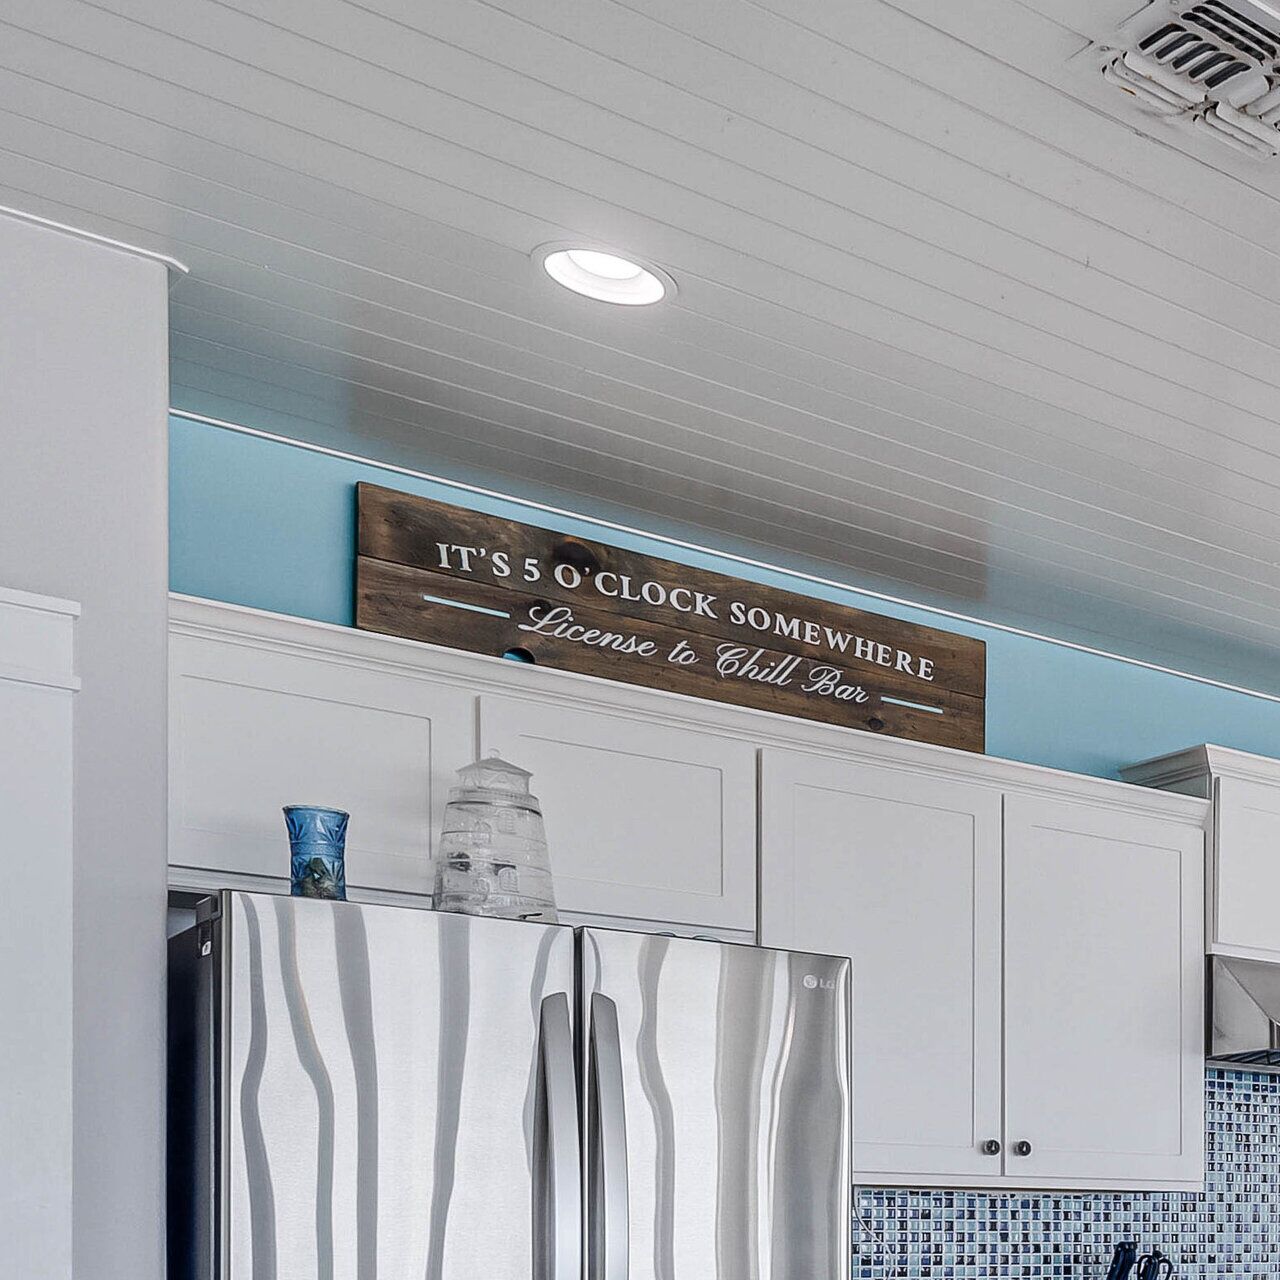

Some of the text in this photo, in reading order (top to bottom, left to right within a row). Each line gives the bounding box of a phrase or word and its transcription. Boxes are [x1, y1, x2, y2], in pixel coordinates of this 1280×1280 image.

[436, 541, 936, 681] IT'S 5 O'CLOCK SOMEWHERE
[517, 605, 871, 704] License to Chill Bar
